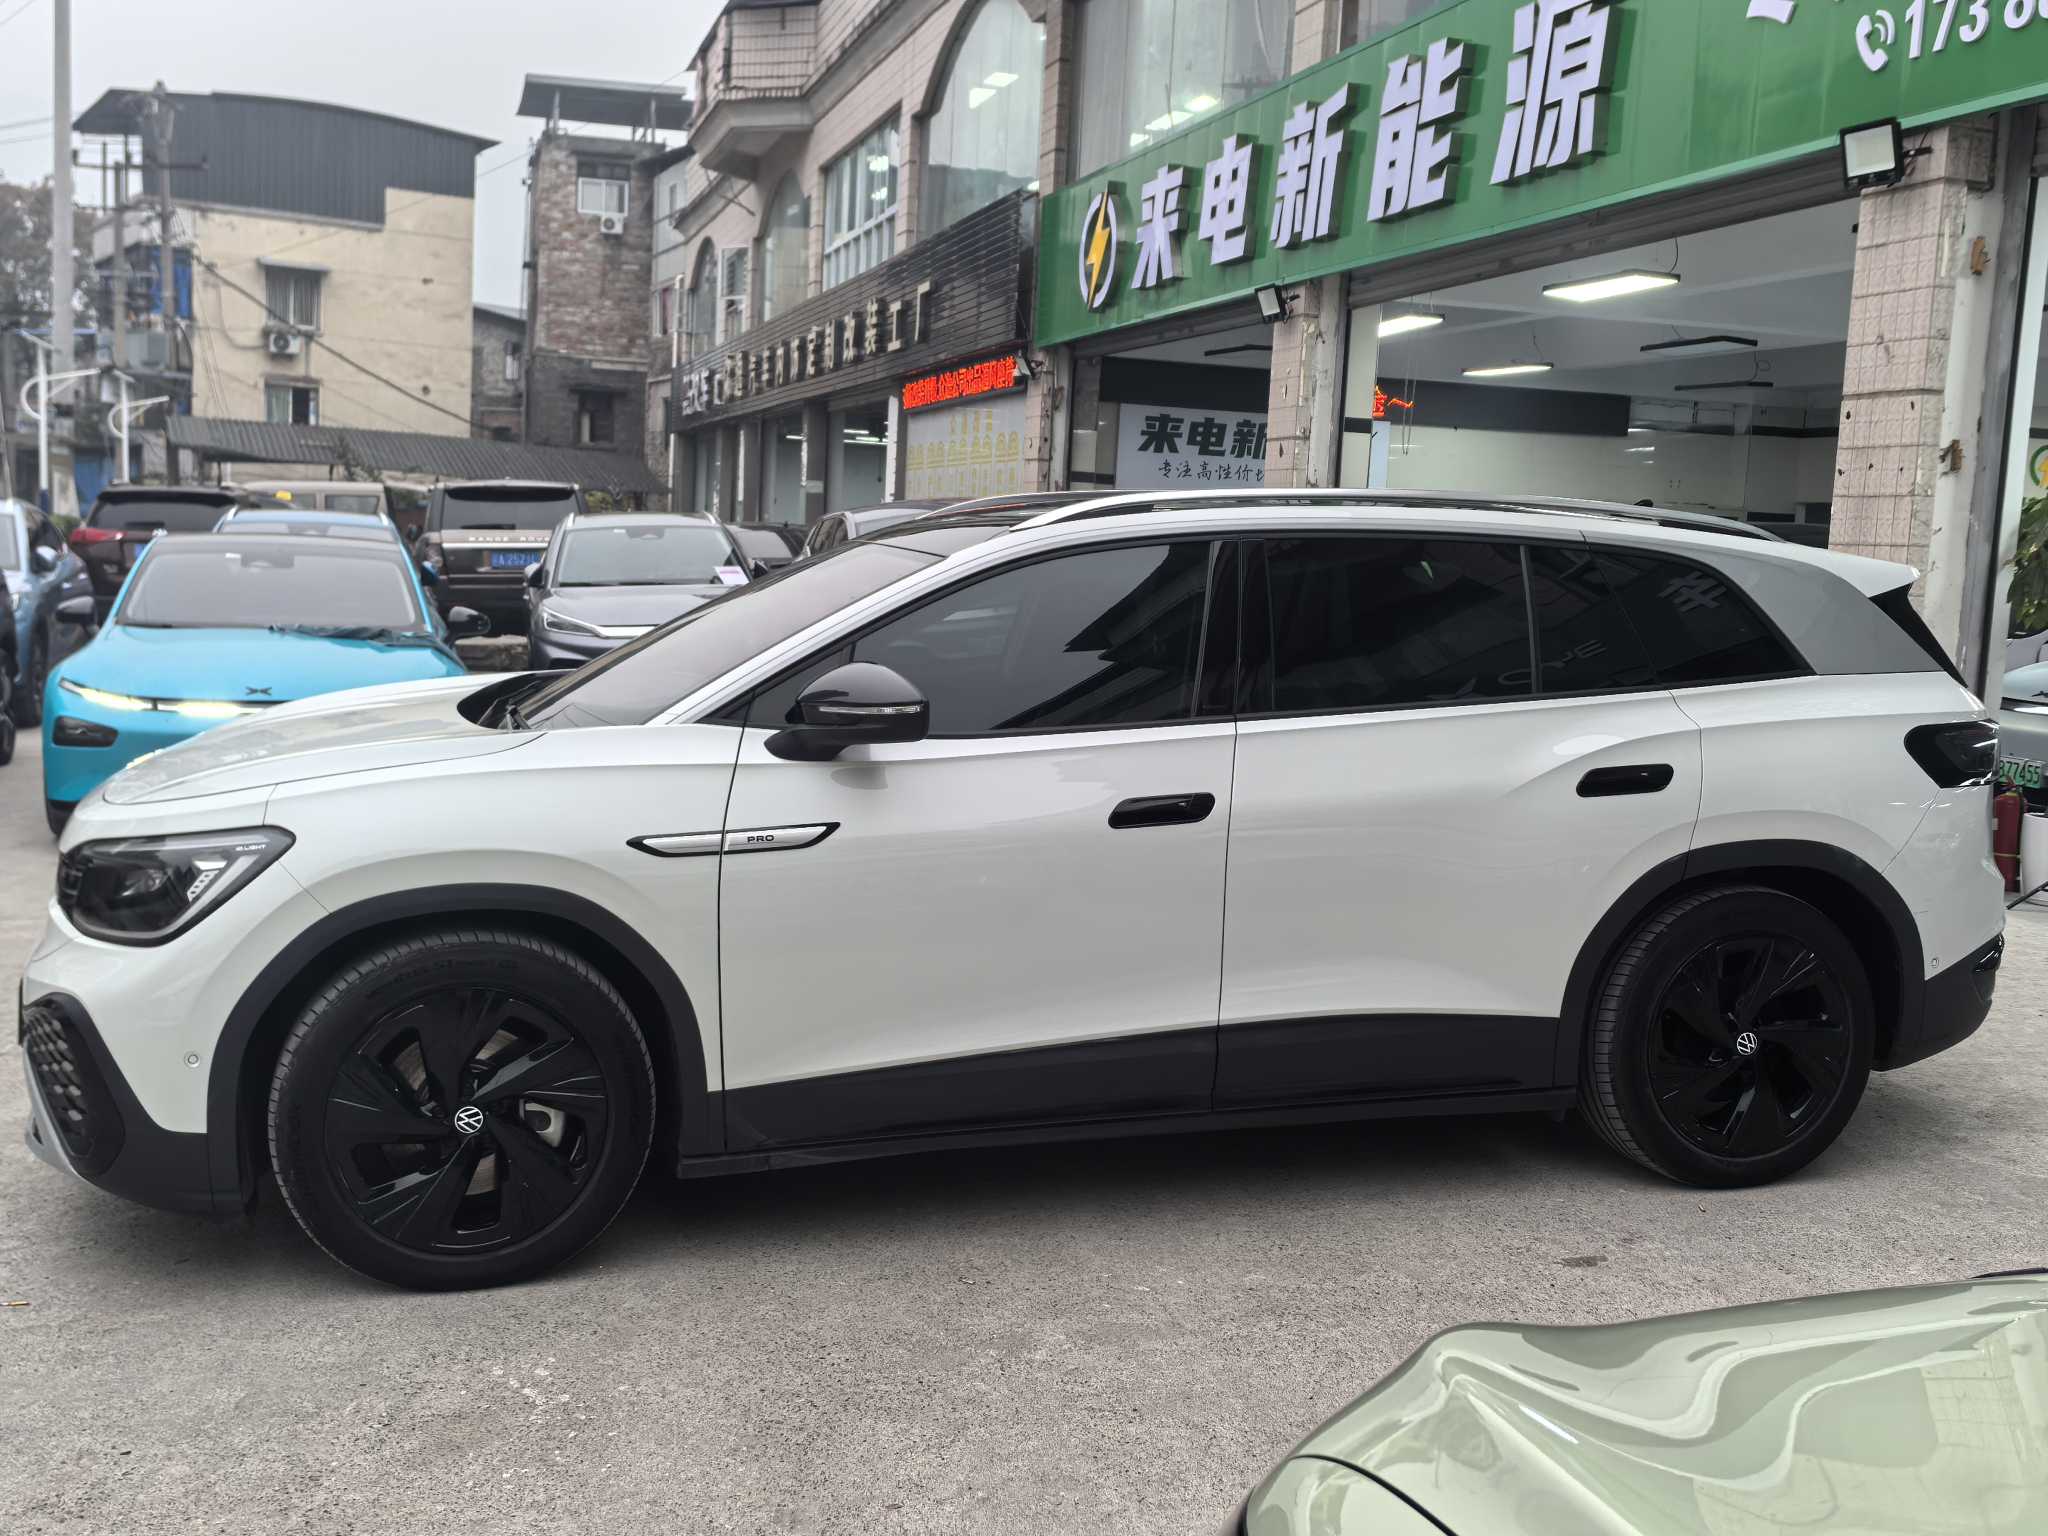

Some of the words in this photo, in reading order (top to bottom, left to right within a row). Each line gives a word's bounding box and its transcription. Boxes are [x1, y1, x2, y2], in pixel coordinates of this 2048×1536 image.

[1131, 0, 1613, 289] 来电新能源
[1137, 413, 1267, 460] 来电新
[747, 834, 775, 843] PRO
